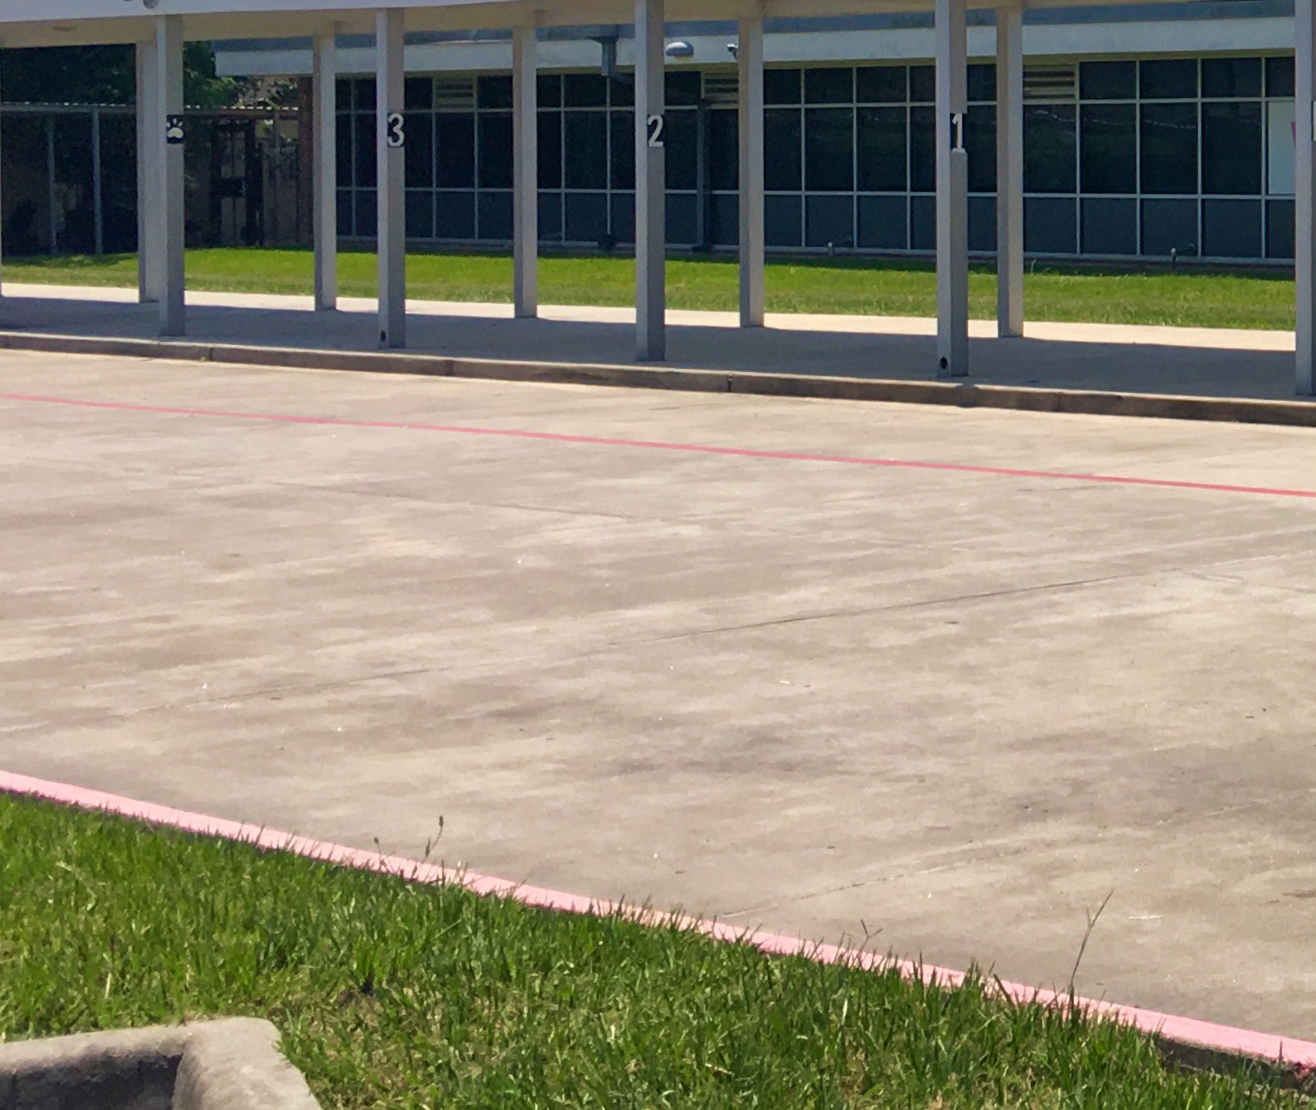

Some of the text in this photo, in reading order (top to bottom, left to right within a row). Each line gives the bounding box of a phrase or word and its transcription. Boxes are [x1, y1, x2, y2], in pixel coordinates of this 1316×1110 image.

[387, 112, 405, 147] 3
[647, 114, 664, 148] 2
[951, 113, 966, 153] 1
